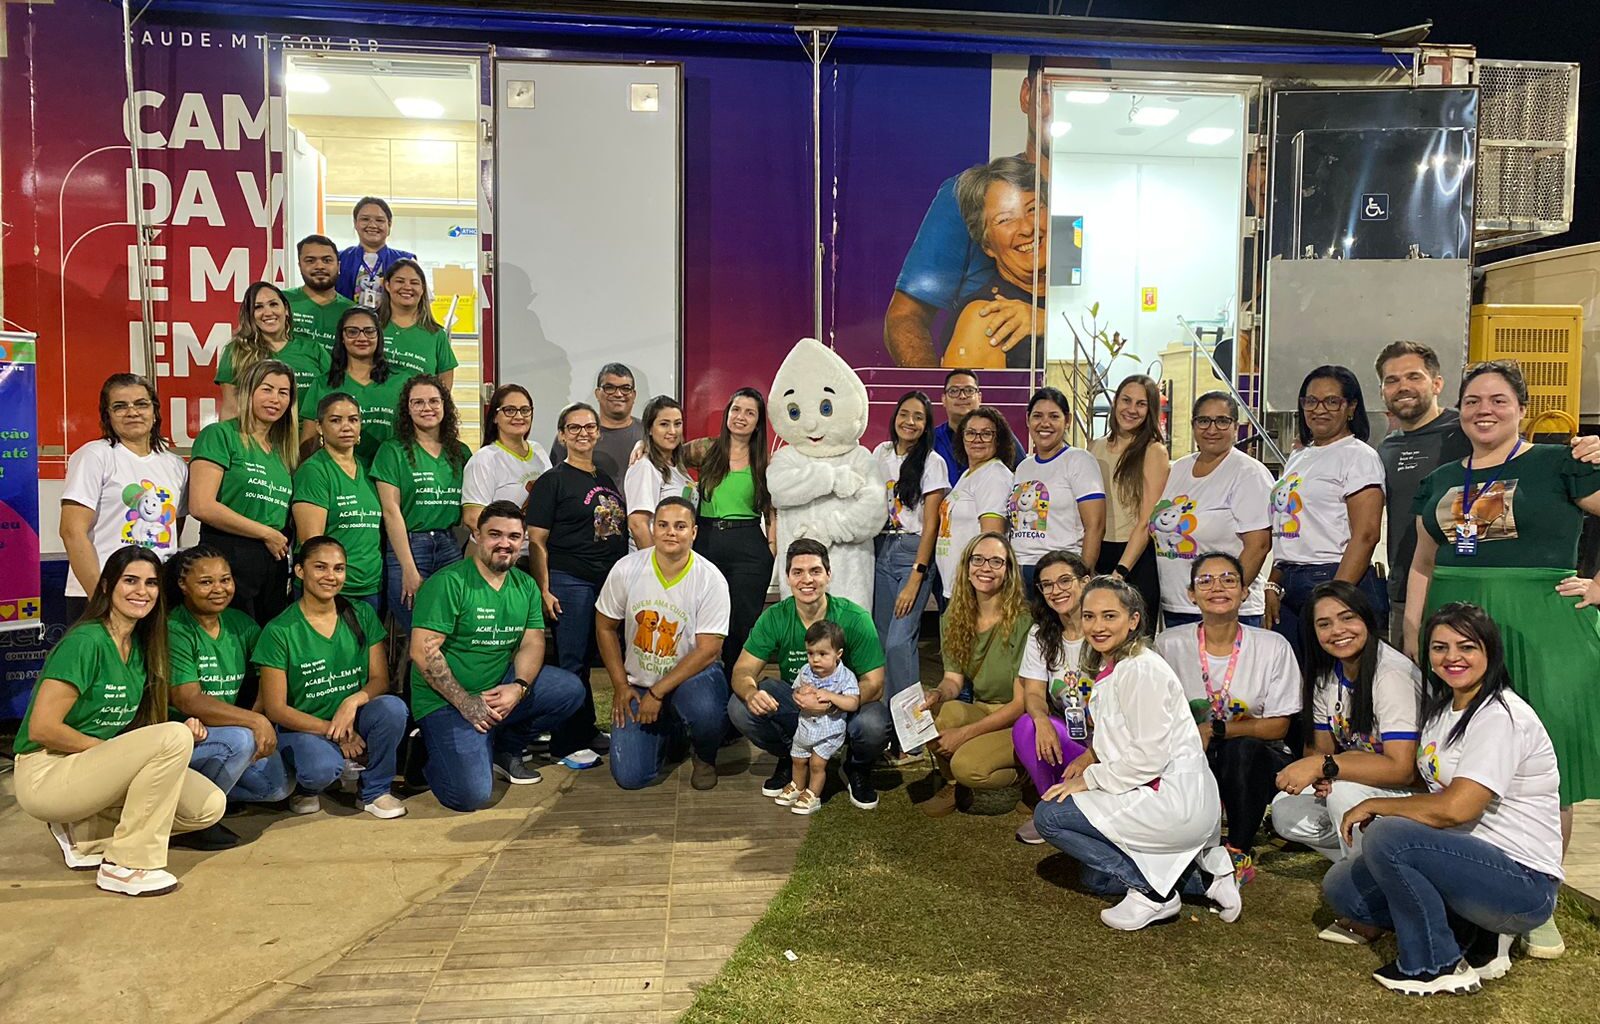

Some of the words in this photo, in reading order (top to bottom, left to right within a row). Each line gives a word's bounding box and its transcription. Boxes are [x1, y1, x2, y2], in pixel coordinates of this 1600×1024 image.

[126, 168, 226, 227] DA
[127, 229, 169, 301] É
[129, 321, 233, 378] EM
[2, 446, 29, 458] até
[305, 677, 325, 687] ACABE
